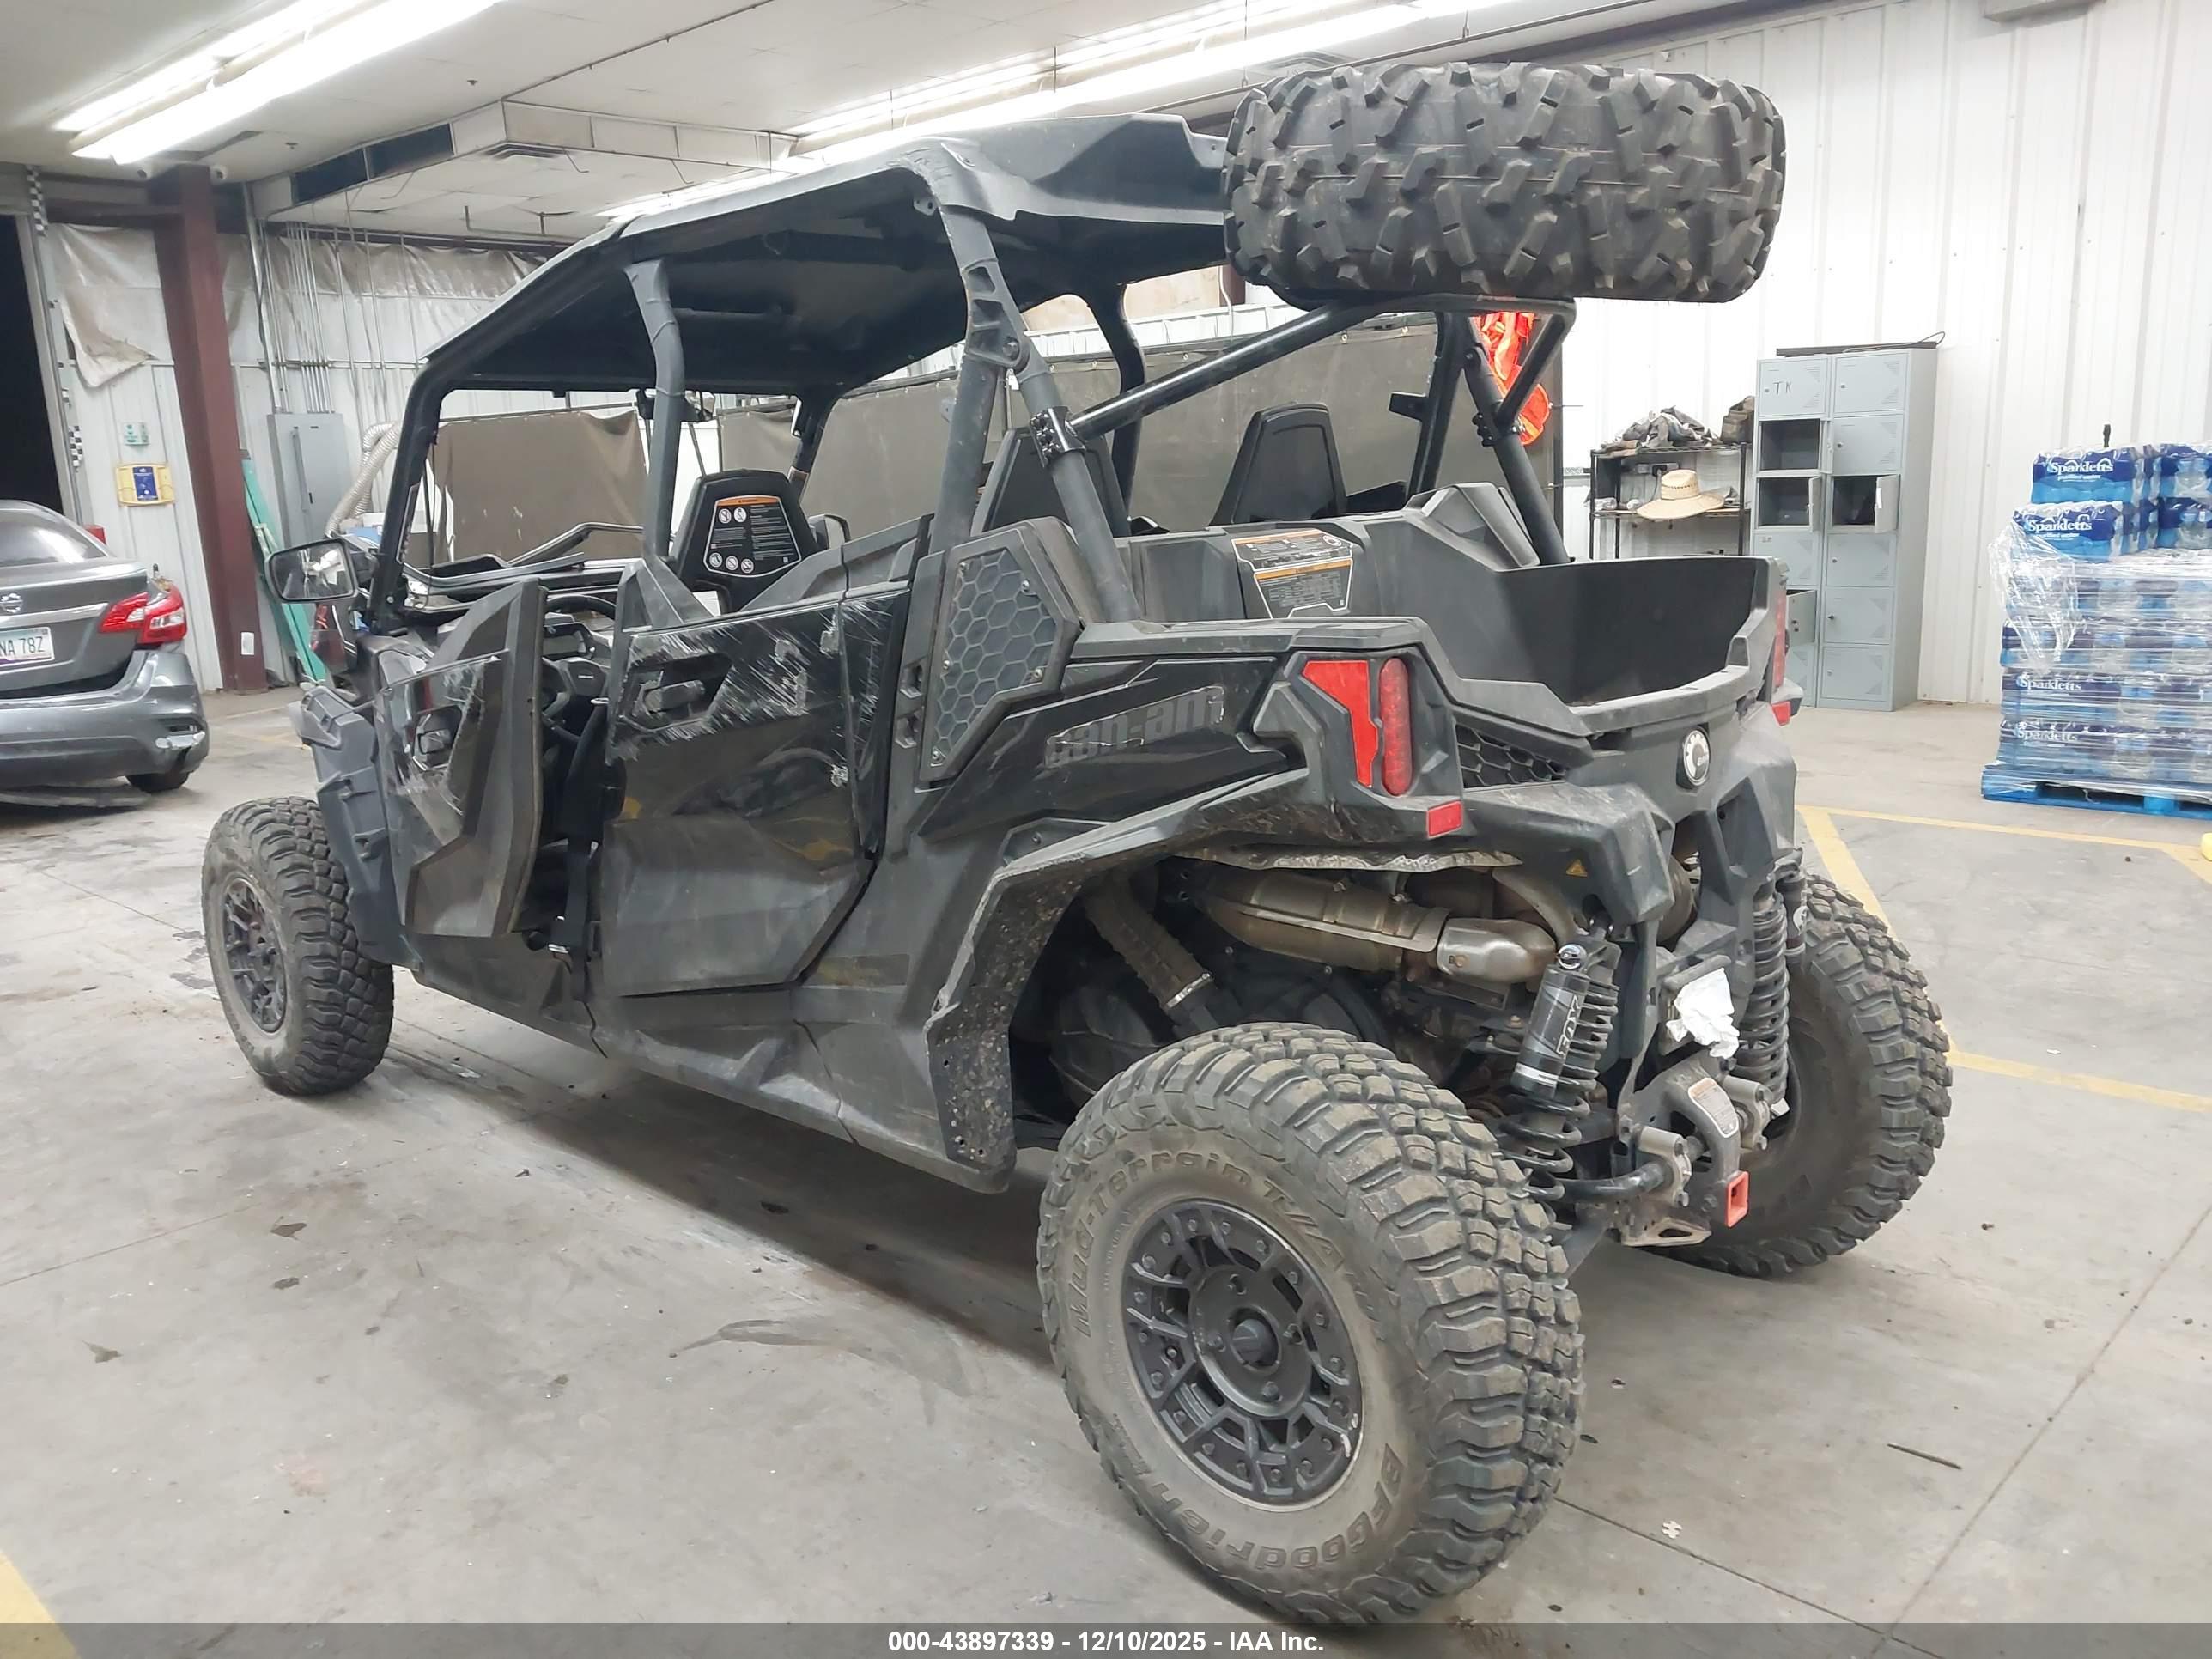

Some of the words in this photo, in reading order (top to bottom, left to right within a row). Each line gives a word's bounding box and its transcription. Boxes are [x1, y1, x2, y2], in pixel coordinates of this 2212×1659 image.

[2049, 458, 2114, 476] Sparkletts
[18, 636, 46, 654] 78Z
[1152, 1443, 1405, 1570] BFGoodrich
